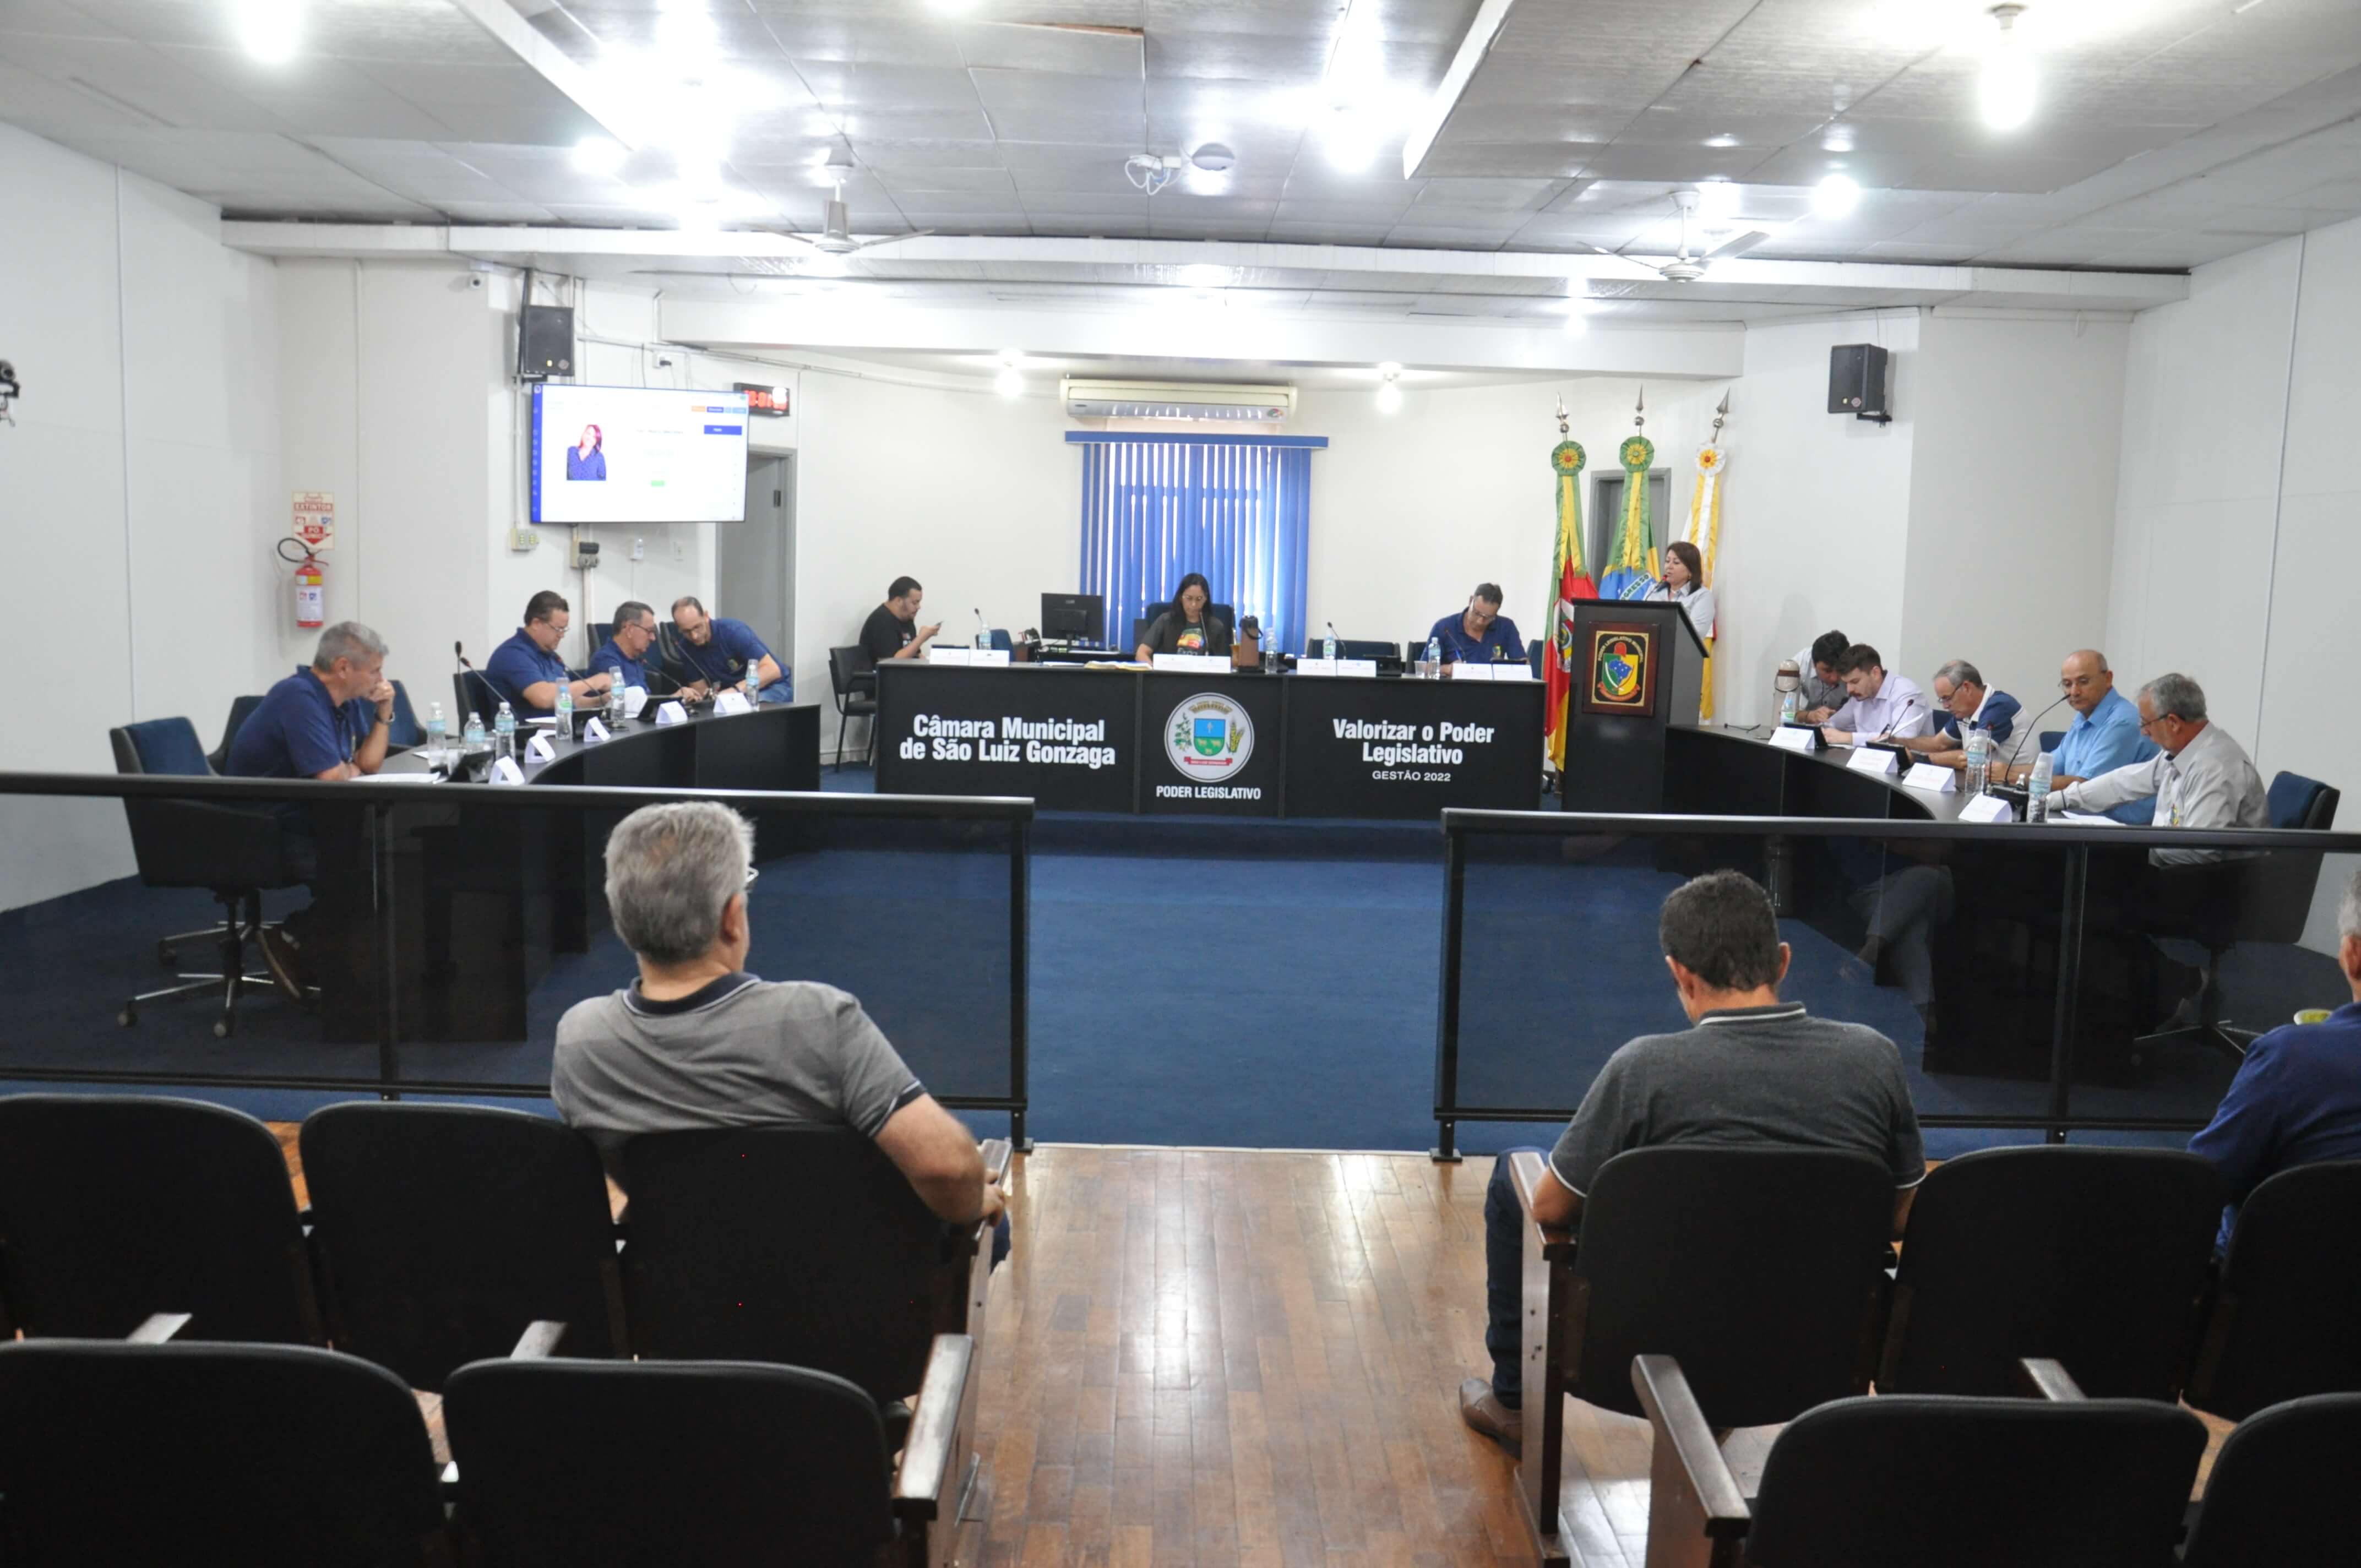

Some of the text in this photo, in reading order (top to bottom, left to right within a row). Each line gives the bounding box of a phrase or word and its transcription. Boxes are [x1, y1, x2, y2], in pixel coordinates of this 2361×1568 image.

[913, 714, 1105, 746] Câmara Municipal
[1332, 718, 1495, 743] Valorizar o Poder
[899, 737, 1116, 770] de São Luiz Gonzaga
[1362, 741, 1463, 767] Legislativo
[1372, 770, 1451, 782] GESTÃO 2022
[1156, 785, 1261, 799] PODER LEGISLATIVO
